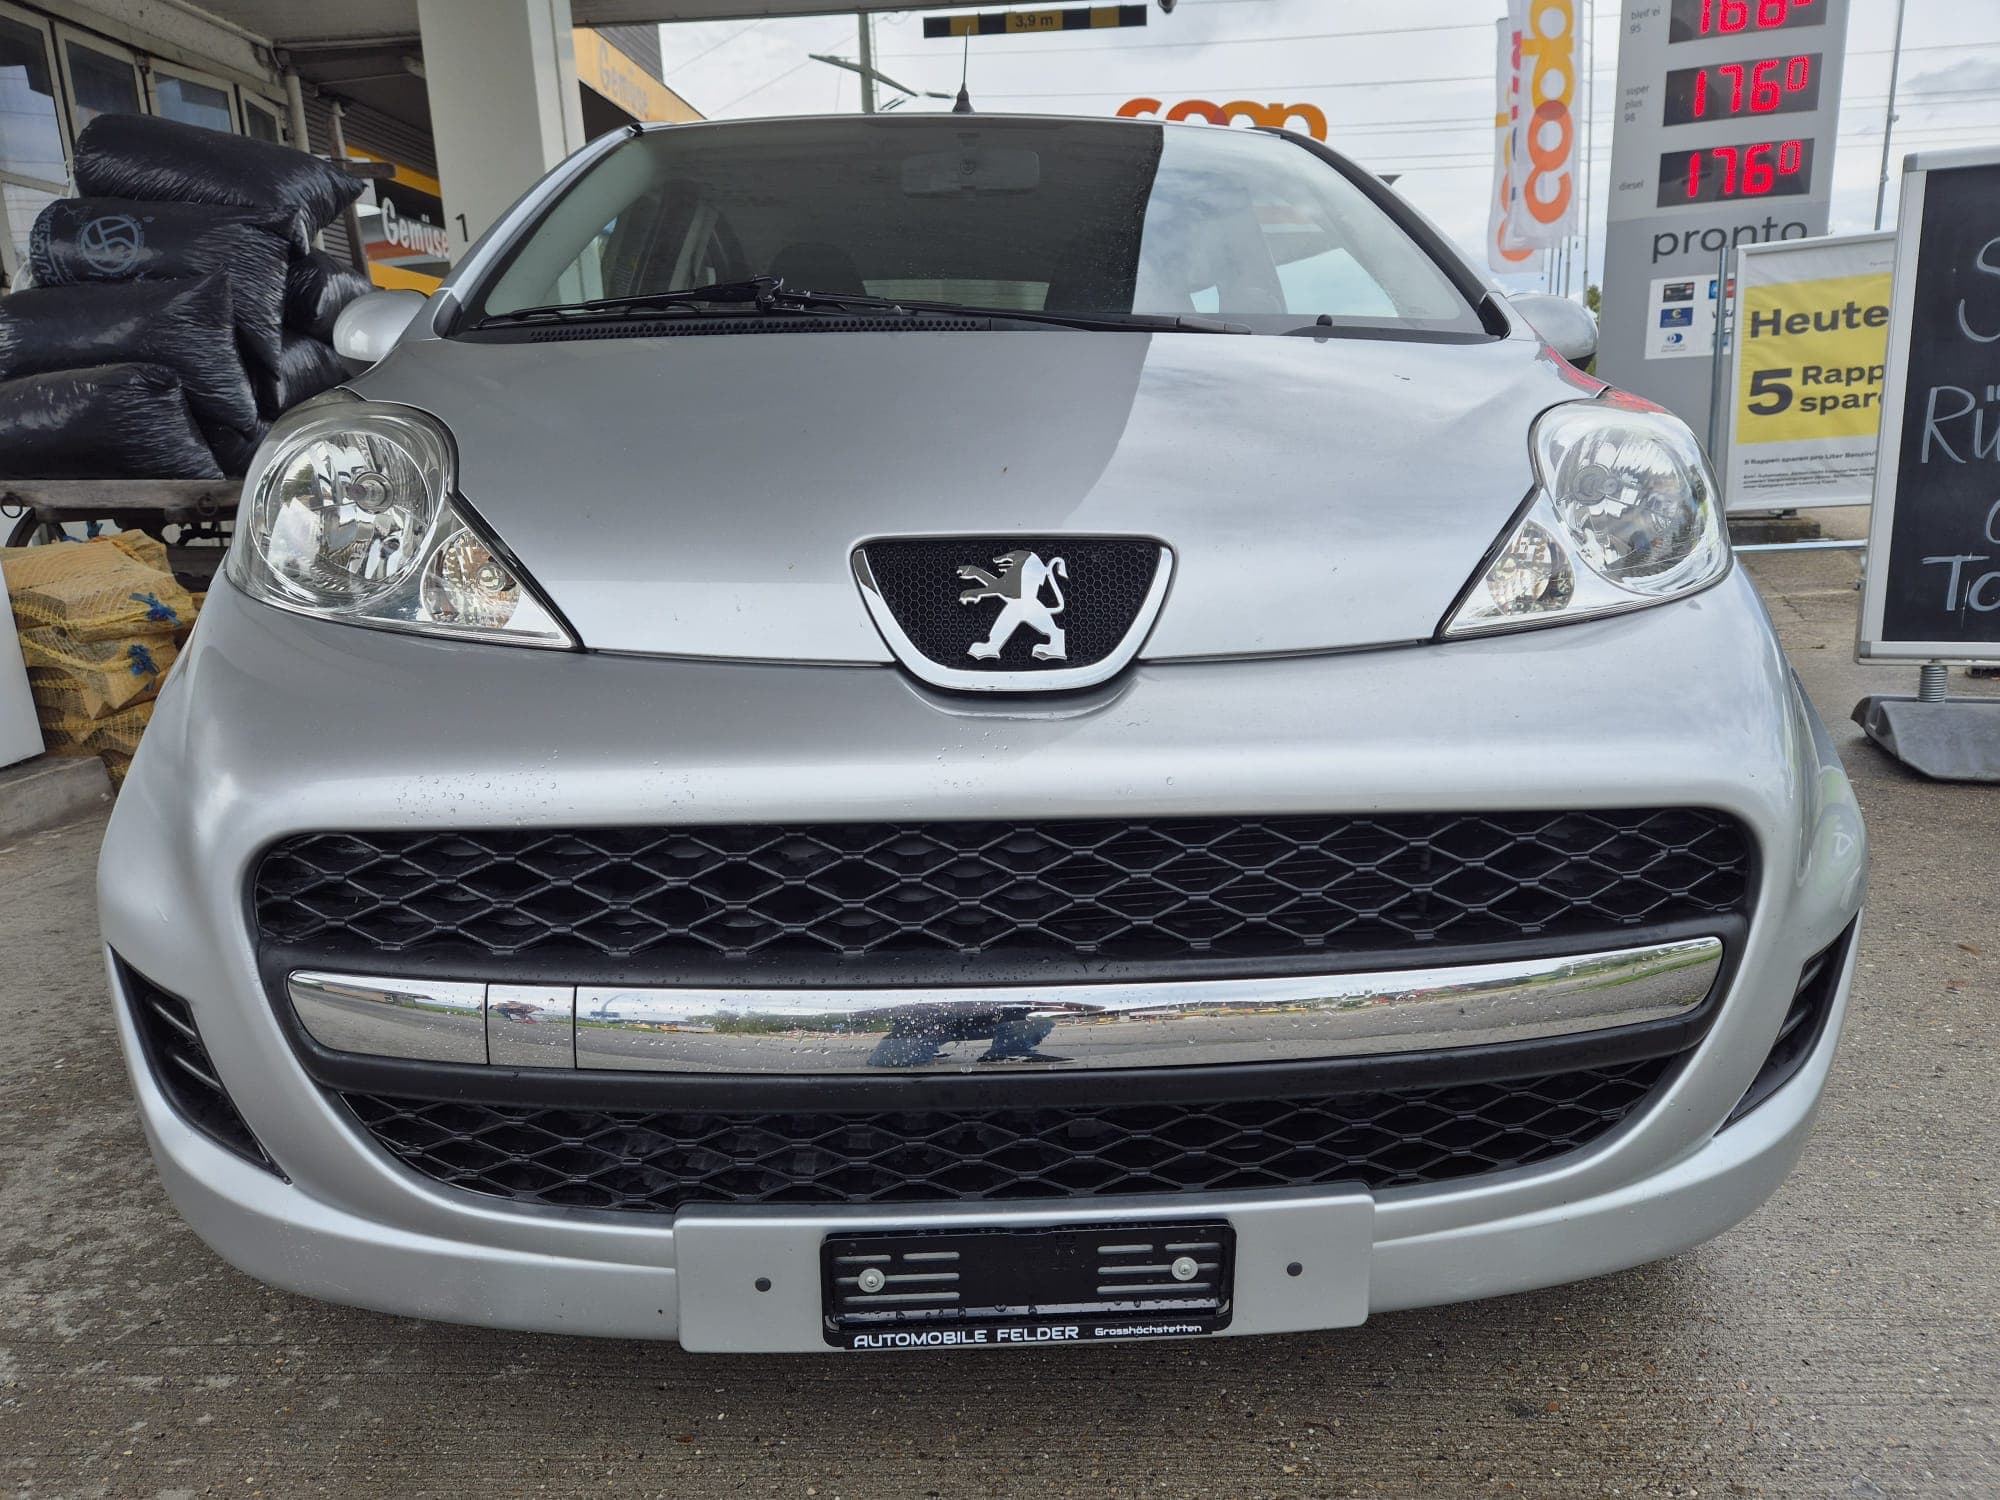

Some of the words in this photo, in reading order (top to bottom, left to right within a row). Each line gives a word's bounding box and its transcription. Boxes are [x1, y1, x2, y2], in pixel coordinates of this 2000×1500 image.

[1016, 15, 1036, 30] 3,9
[1041, 15, 1053, 26] m
[1630, 23, 1641, 34] 95
[1626, 84, 1649, 97] super
[1522, 0, 1575, 225] coop
[1619, 179, 1644, 191] diesel
[455, 213, 468, 242] 1
[1652, 216, 1808, 264] pronto
[1750, 301, 1889, 338] Heute
[1747, 368, 1793, 415] 5
[1802, 365, 1884, 387] Rapp
[1800, 391, 1882, 415] spar
[854, 1329, 988, 1348] AUTOMOBILE
[997, 1325, 1079, 1342] FELDER
[1094, 1324, 1202, 1337] Grosshöchstetten
